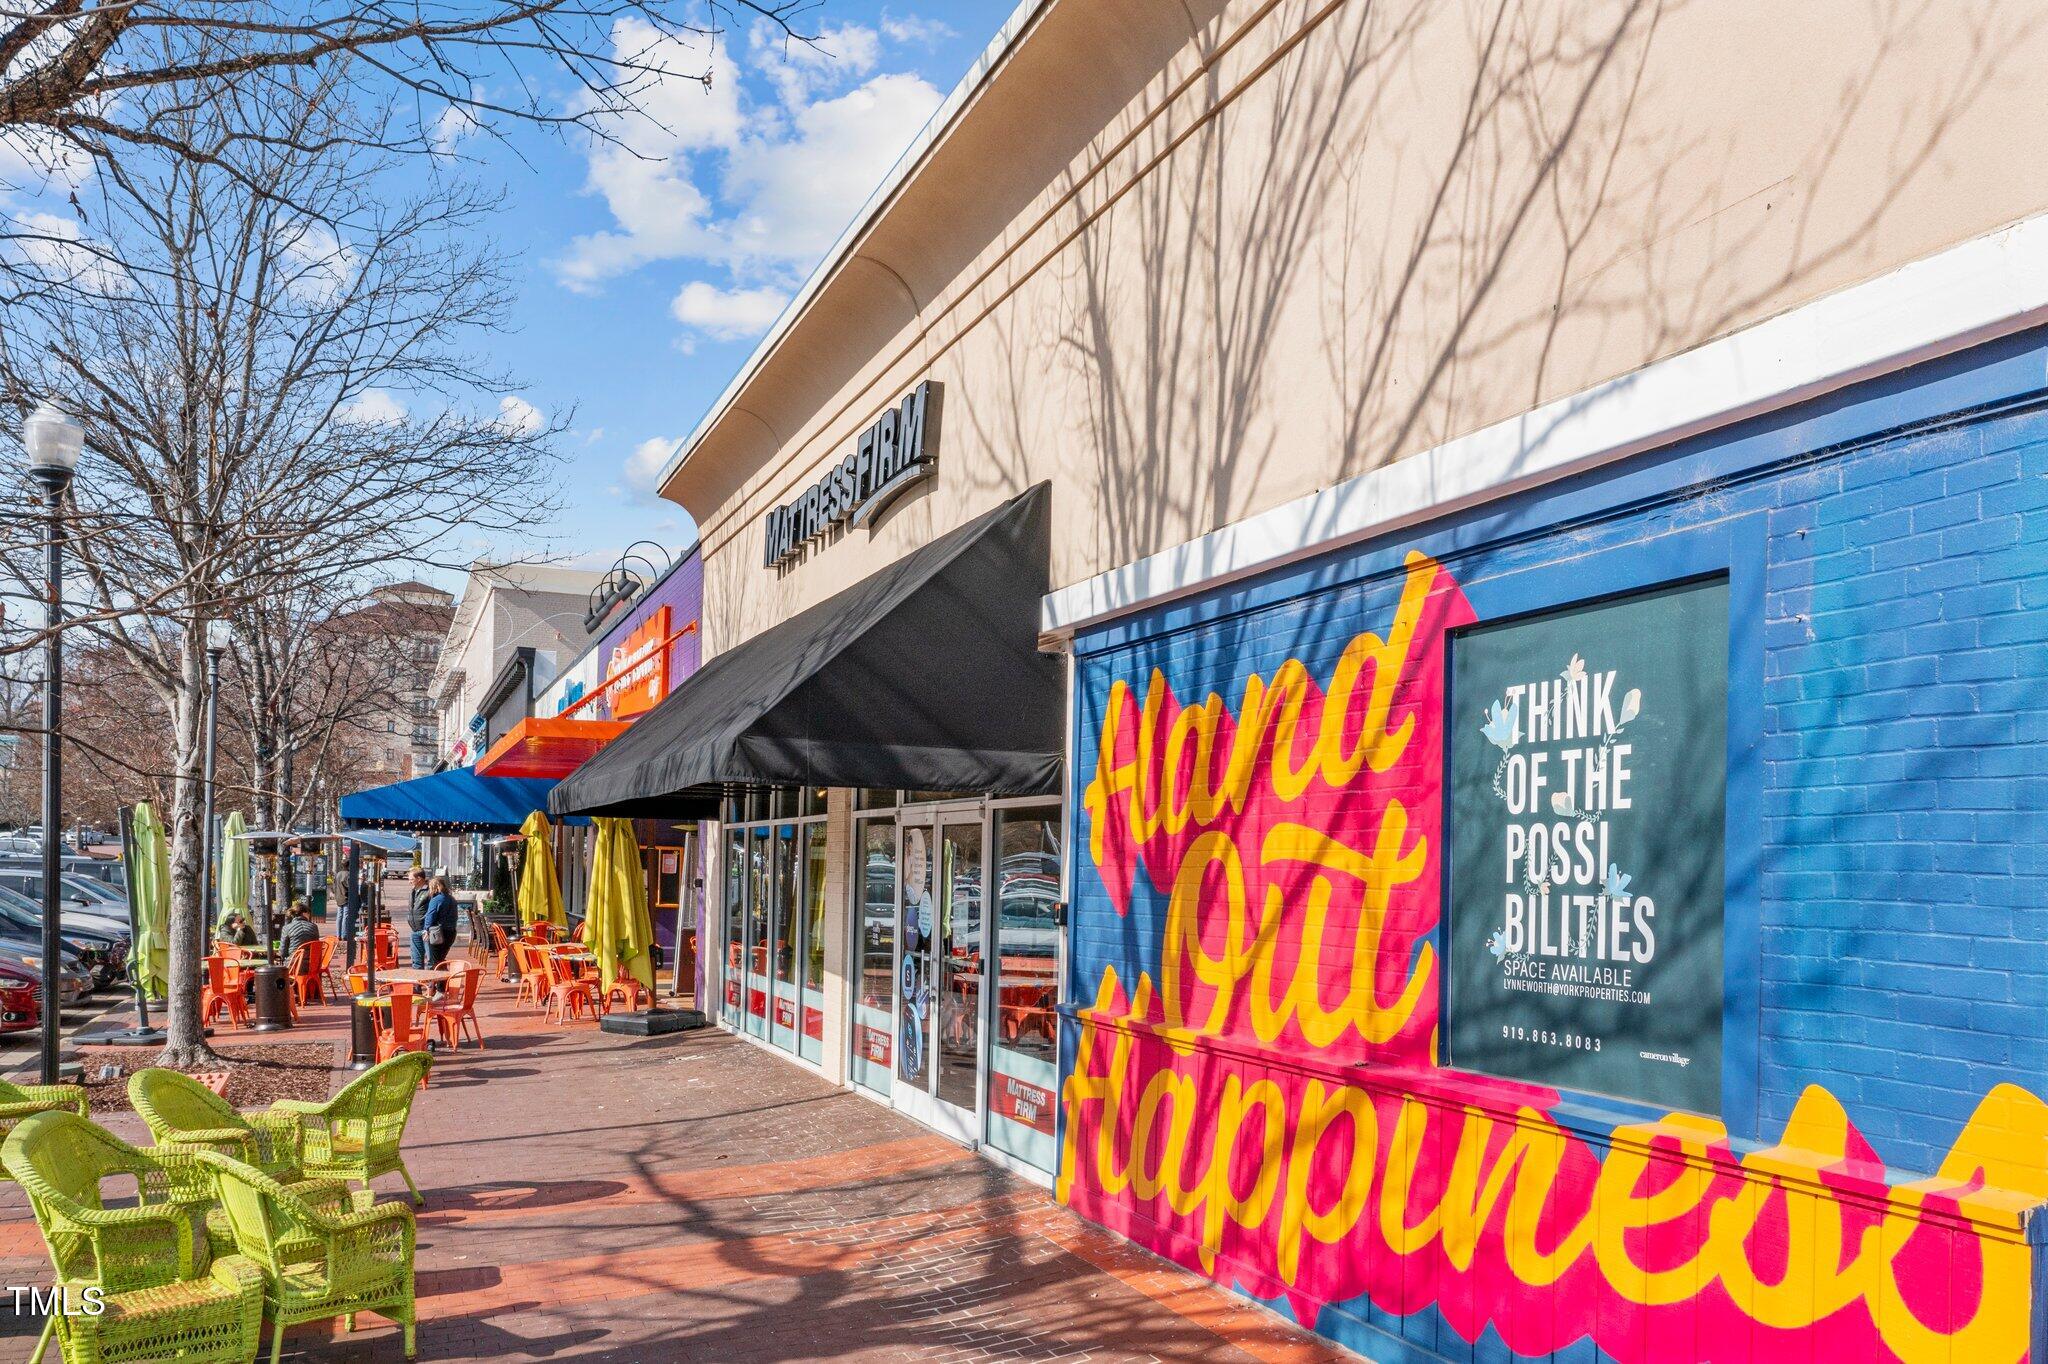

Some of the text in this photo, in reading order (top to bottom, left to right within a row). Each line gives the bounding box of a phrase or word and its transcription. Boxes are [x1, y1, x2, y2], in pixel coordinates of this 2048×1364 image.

[1084, 549, 1438, 867] Hand
[1505, 670, 1617, 745] THINK
[1506, 744, 1632, 815] OF THE
[1505, 820, 1609, 886] POSSI
[1151, 799, 1434, 1057] Out
[1504, 893, 1655, 964] BILITIES
[1503, 959, 1632, 987] SPACE AVAILABLE
[1503, 978, 1651, 1005] LYNNEWORTH@YORKPROPERTIES.COM
[1502, 1025, 1601, 1052] 919.863.8083
[1006, 1078, 1046, 1107] MATTRESS
[1014, 1098, 1038, 1122] FIRM
[1056, 964, 2048, 1364] Happiness
